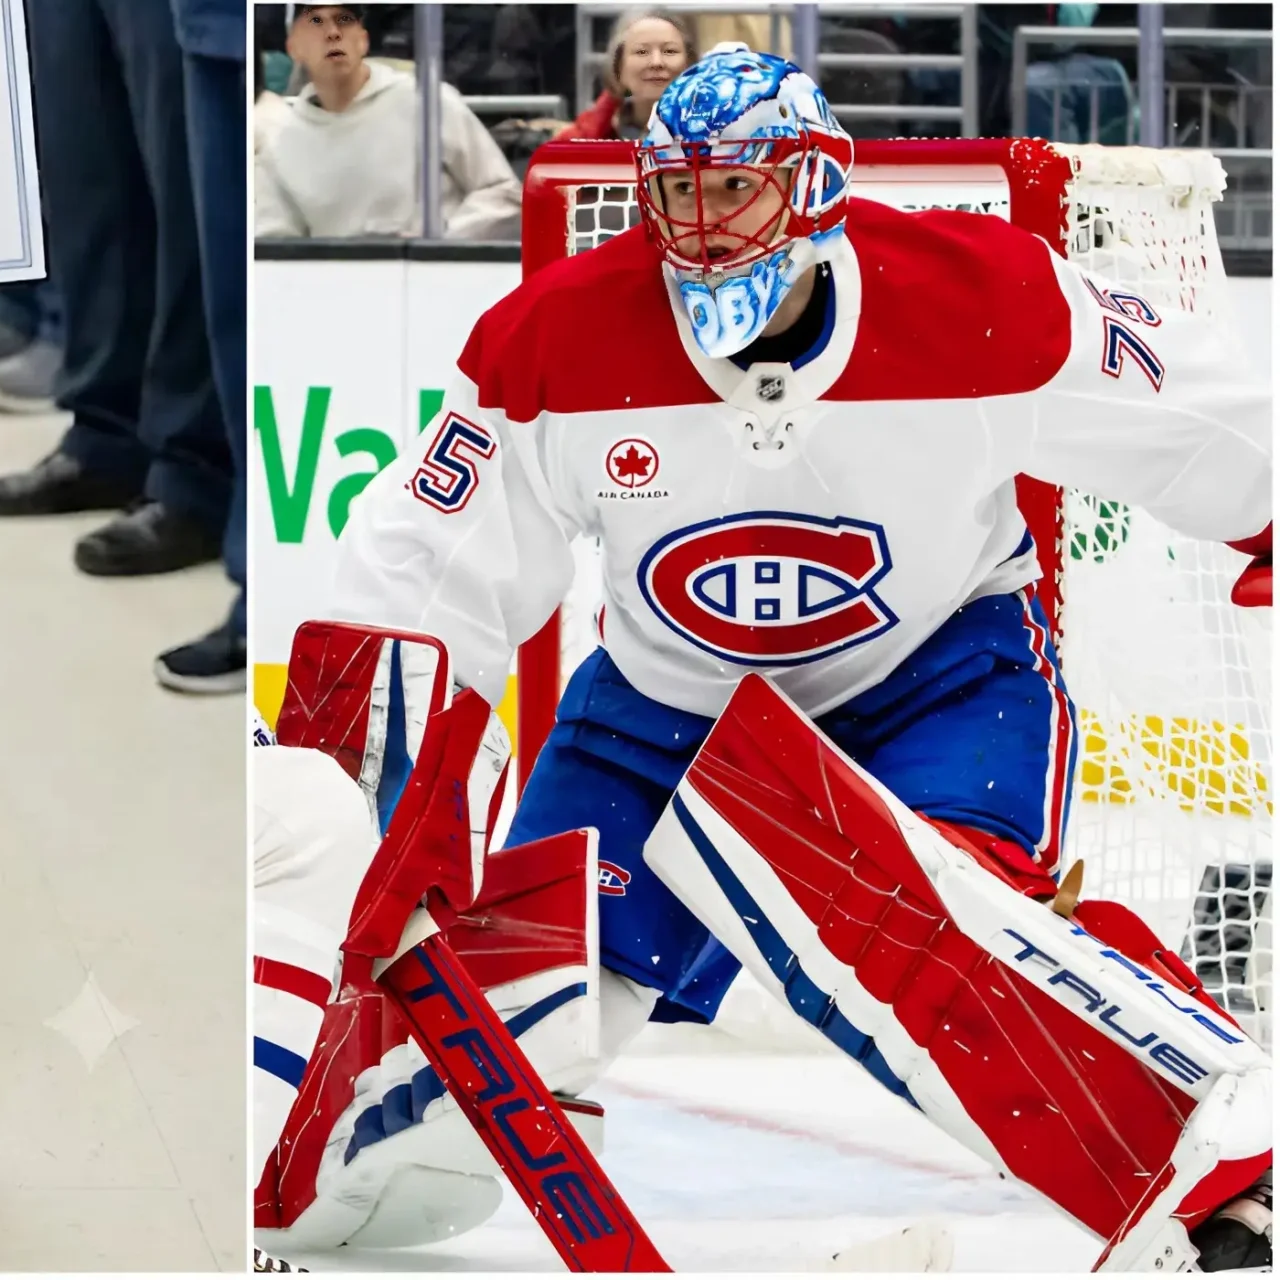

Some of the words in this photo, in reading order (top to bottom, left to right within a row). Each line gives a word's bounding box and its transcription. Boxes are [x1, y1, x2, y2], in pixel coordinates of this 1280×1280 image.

[597, 491, 618, 499] AIR
[620, 490, 670, 500] CANADA
[1003, 928, 1210, 1086] TRUE
[406, 945, 617, 1245] TRUE
